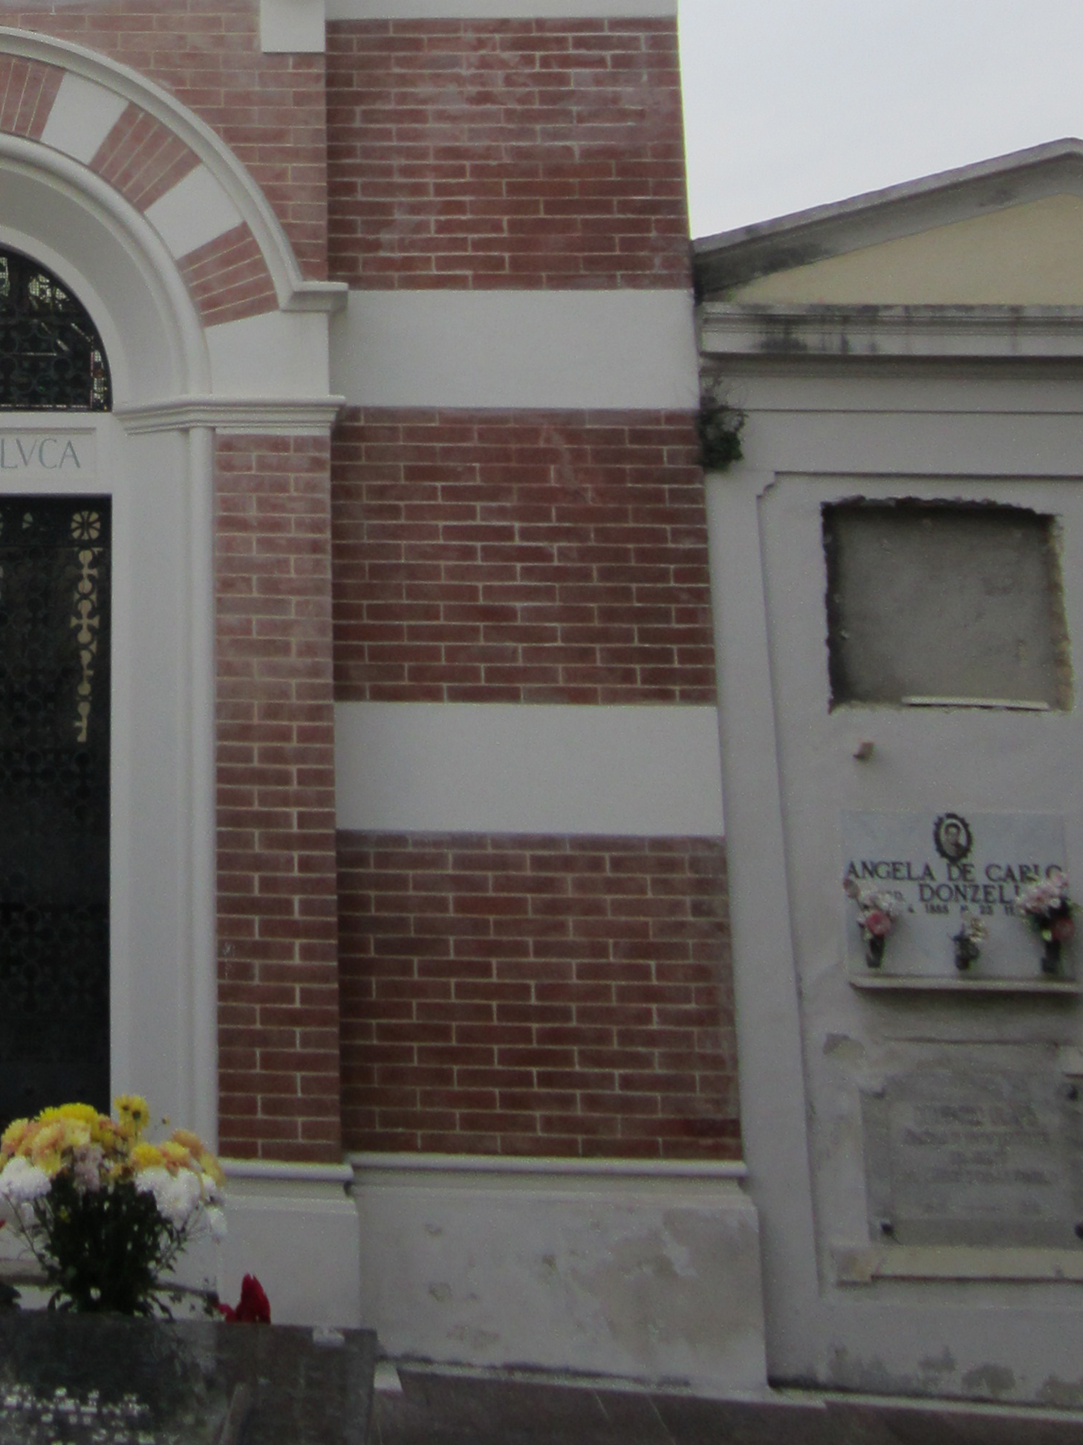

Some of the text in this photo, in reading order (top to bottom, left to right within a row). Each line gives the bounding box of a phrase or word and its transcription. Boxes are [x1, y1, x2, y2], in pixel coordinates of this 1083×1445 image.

[0, 436, 82, 470] LVCA
[845, 859, 937, 882] ANGELA
[946, 862, 977, 883] DE
